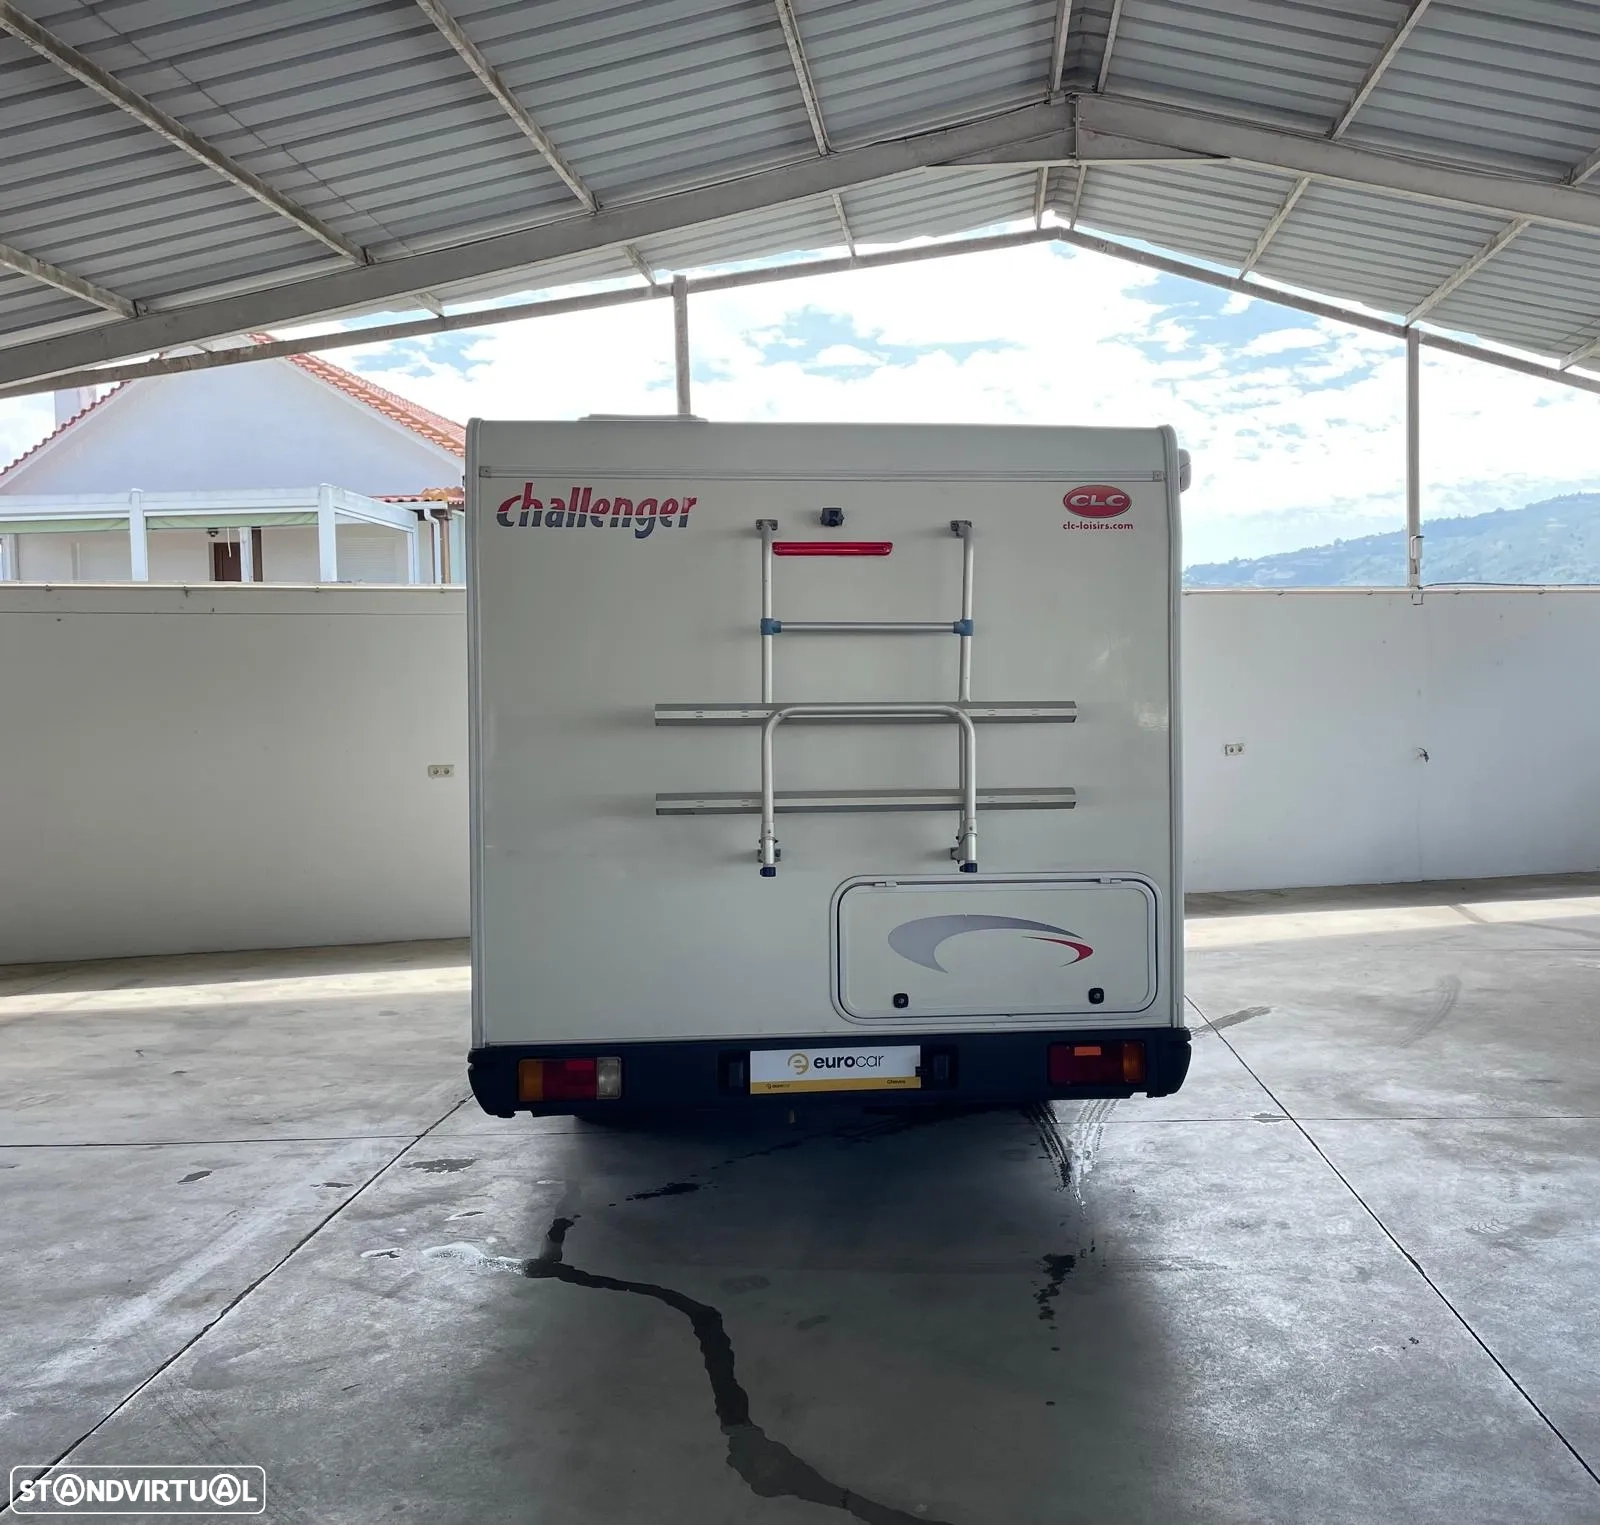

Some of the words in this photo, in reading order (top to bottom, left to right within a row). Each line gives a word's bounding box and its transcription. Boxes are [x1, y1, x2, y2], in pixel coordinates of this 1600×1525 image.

[1070, 494, 1125, 507] CLC
[496, 482, 698, 539] challenger
[1062, 521, 1134, 530] clc-loisirs.com
[813, 1055, 885, 1069] eurocar
